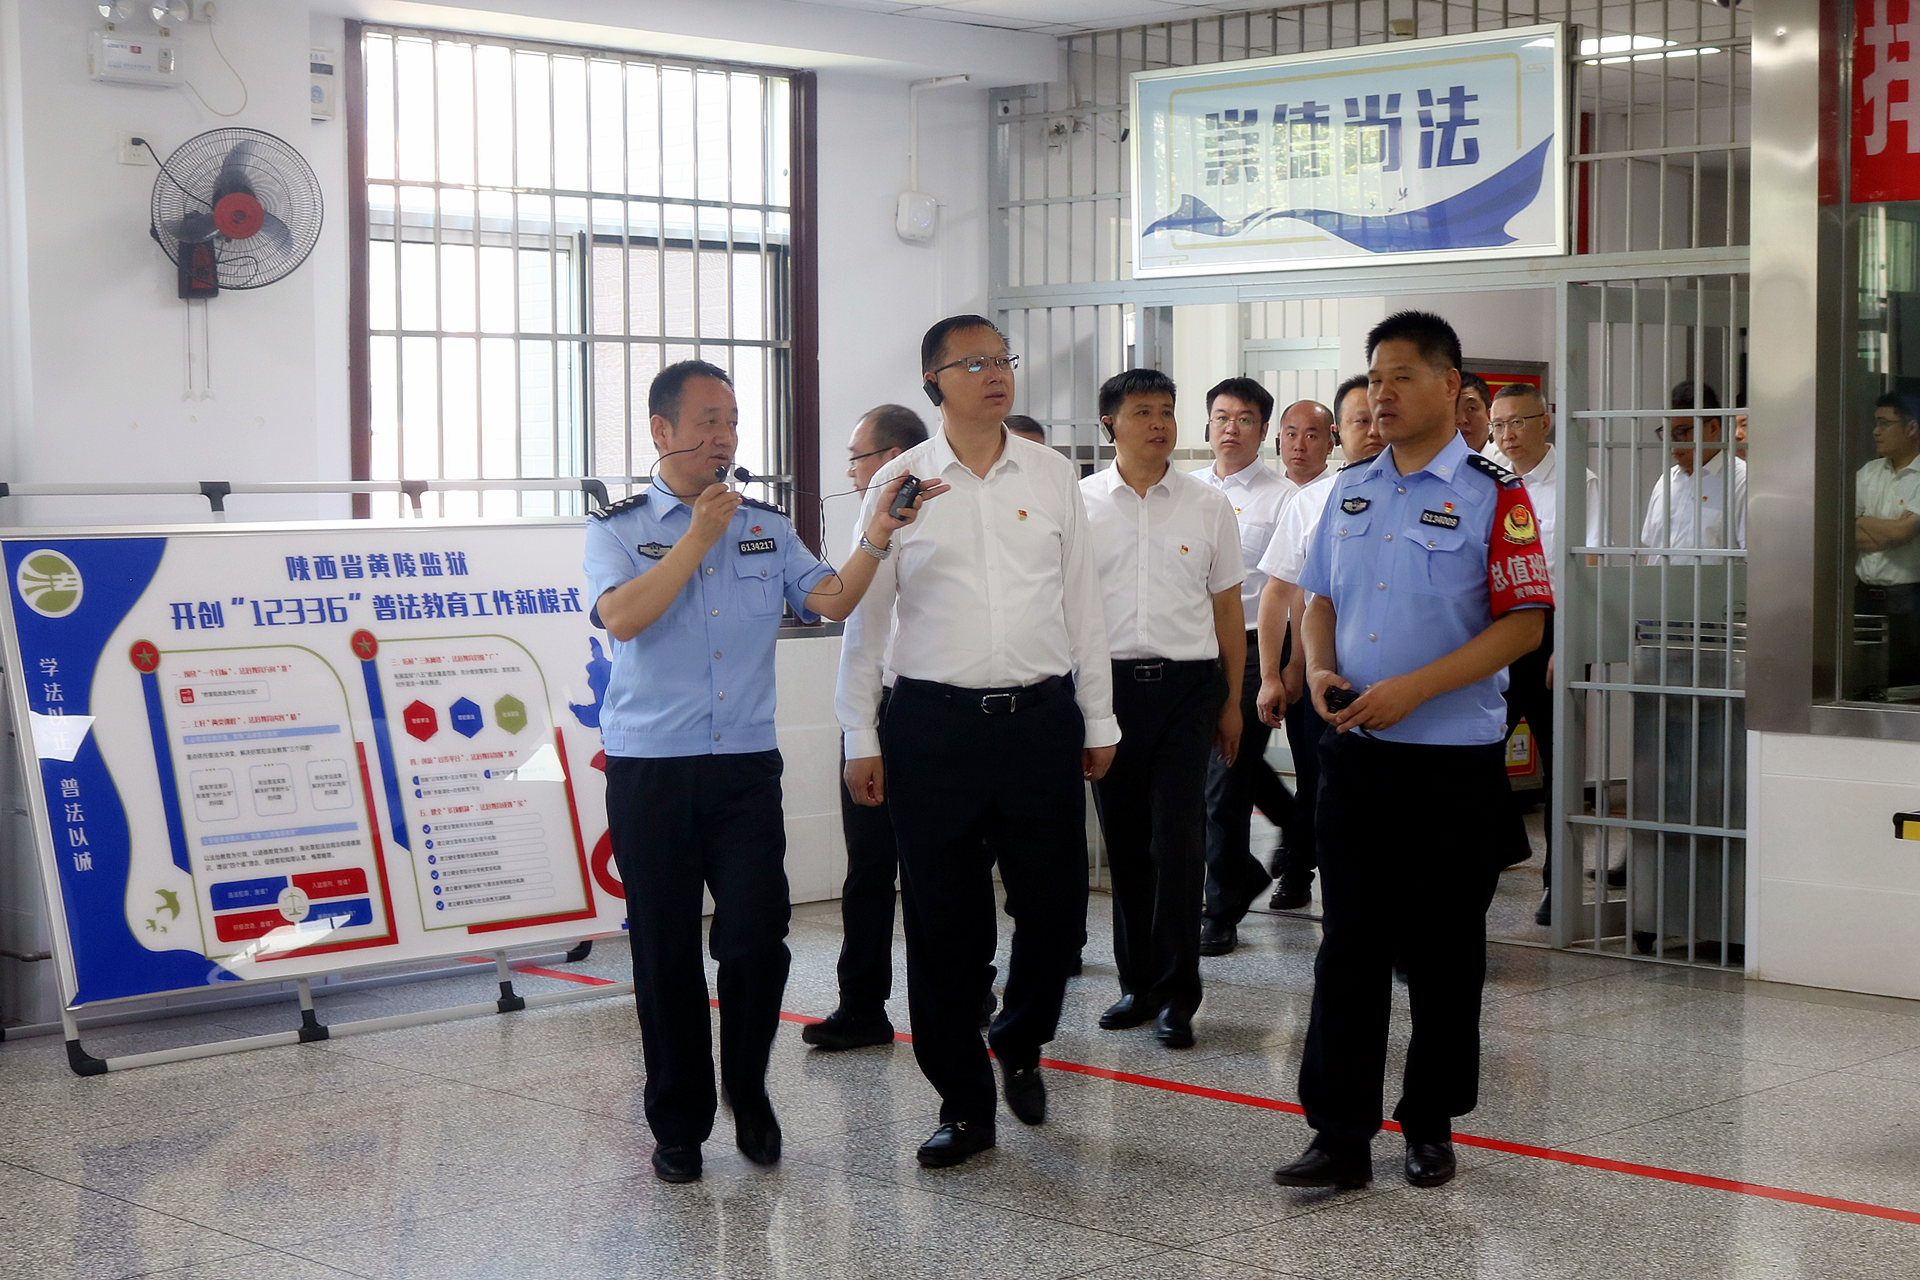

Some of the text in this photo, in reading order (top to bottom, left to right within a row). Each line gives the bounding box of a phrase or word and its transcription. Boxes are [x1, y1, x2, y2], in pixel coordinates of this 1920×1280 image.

[1204, 85, 1480, 186] 崇德尚法
[285, 551, 470, 581] 陕西省黄陵监狱
[740, 540, 774, 552] 6134217
[1490, 552, 1548, 592] 总值班
[60, 777, 94, 872] 普法以诚
